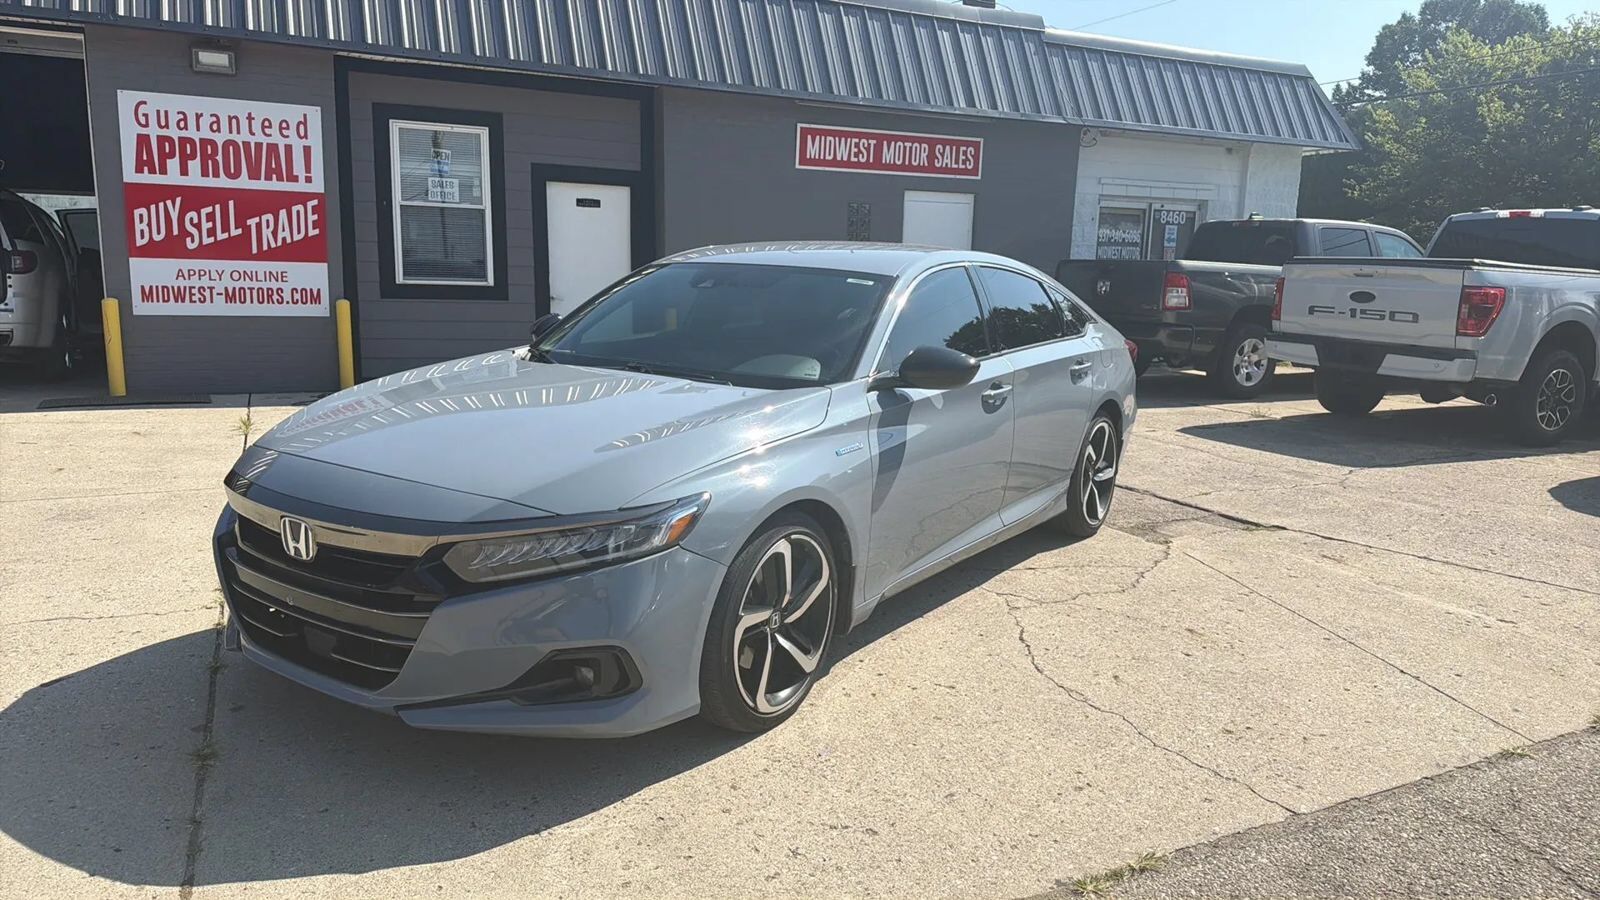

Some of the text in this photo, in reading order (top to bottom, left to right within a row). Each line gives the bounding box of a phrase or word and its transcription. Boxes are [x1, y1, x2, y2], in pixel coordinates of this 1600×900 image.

[133, 100, 309, 140] Guaranteed
[134, 133, 313, 184] APPROVAL!
[431, 150, 450, 161] OPEN
[806, 134, 975, 170] MIDWEST MOTOR SALES
[431, 179, 454, 190] SALES
[430, 190, 456, 201] OFFICE
[133, 197, 320, 255] BUY SELL TRADE
[1160, 210, 1186, 225] 8460
[1097, 246, 1121, 259] MIDWEST
[175, 268, 289, 283] APPLY ONLINE
[140, 284, 322, 305] MIDWEST-MOTORS.COM
[1308, 304, 1420, 324] F-150
